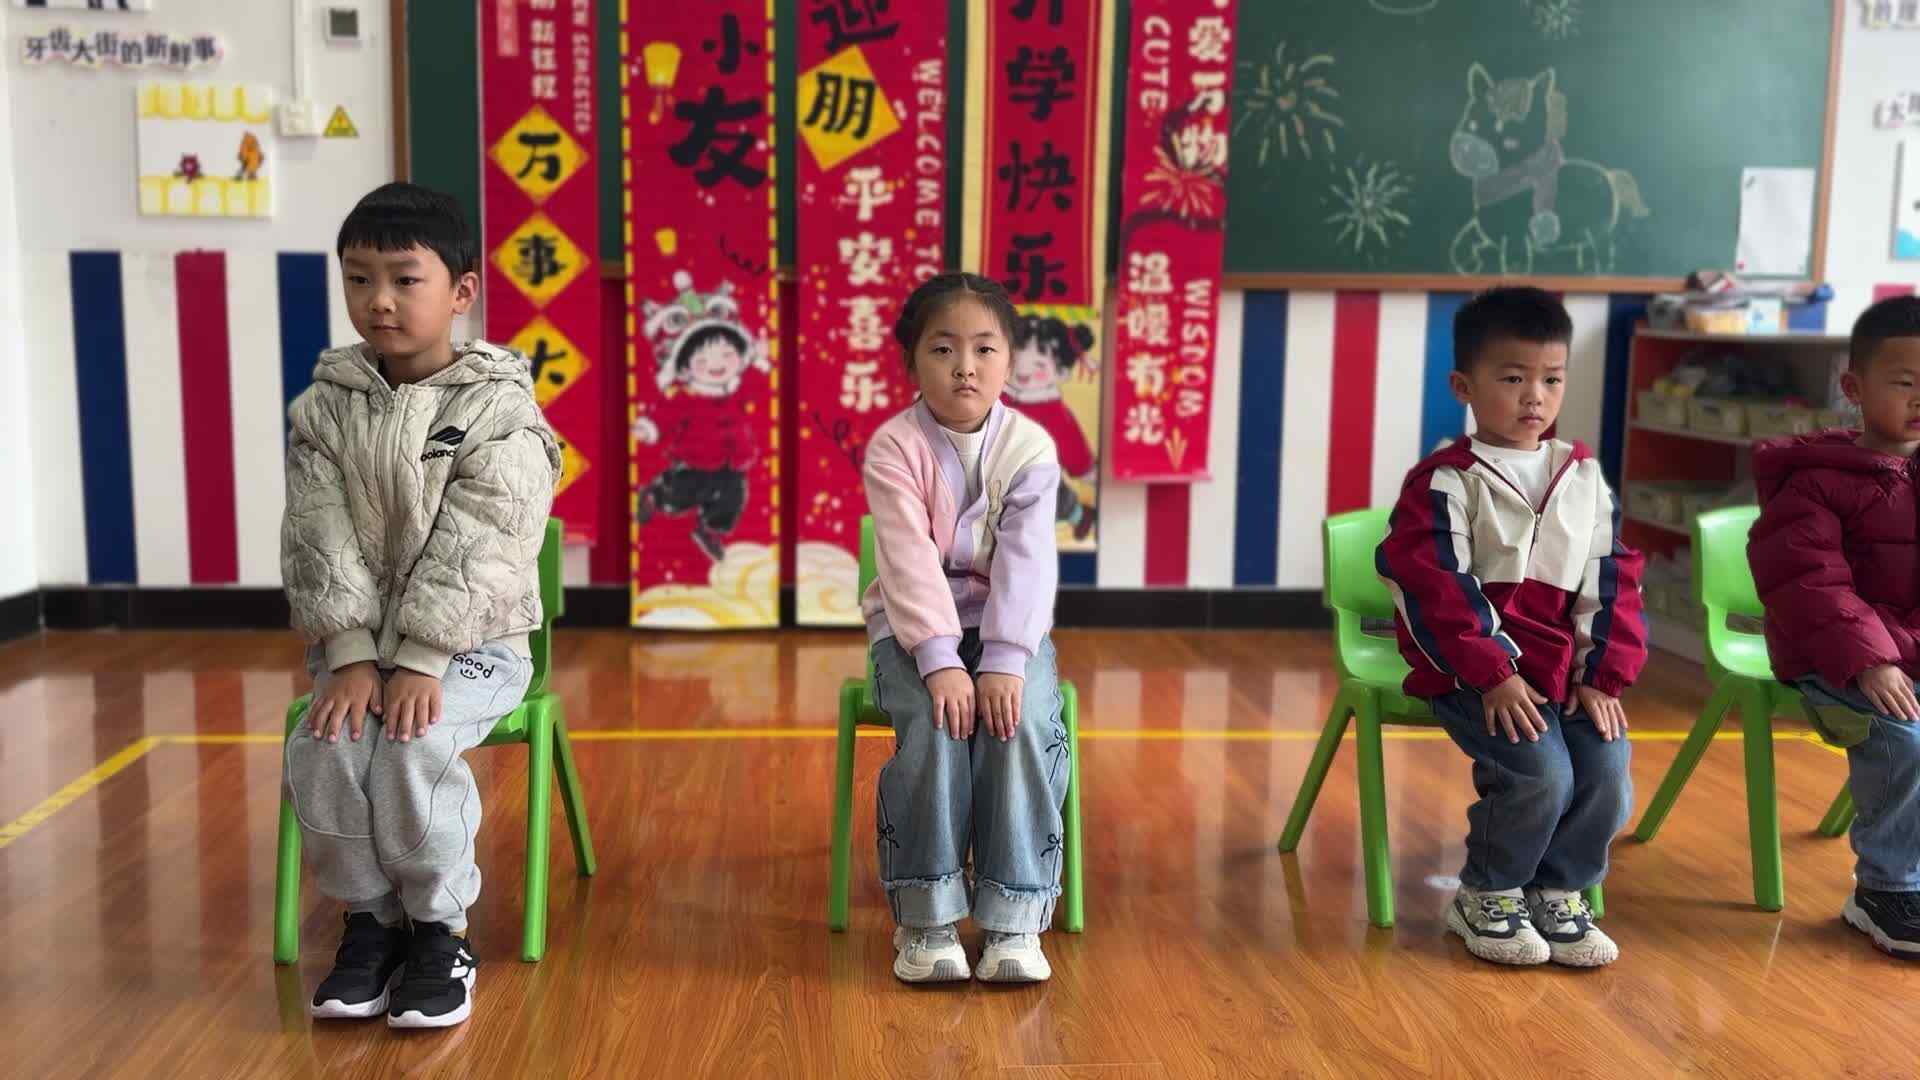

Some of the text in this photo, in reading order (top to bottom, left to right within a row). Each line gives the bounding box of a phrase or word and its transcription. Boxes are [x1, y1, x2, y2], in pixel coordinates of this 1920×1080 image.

[26, 27, 217, 66] 牙齿大街的新鲜事
[1140, 15, 1171, 110] CUTE
[1180, 0, 1230, 166] 爱万物
[912, 58, 943, 228] WELCOME
[512, 131, 569, 478] 万事大
[837, 164, 894, 412] 平安喜乐
[1175, 278, 1212, 418] WISDOM
[452, 652, 496, 679] Good
